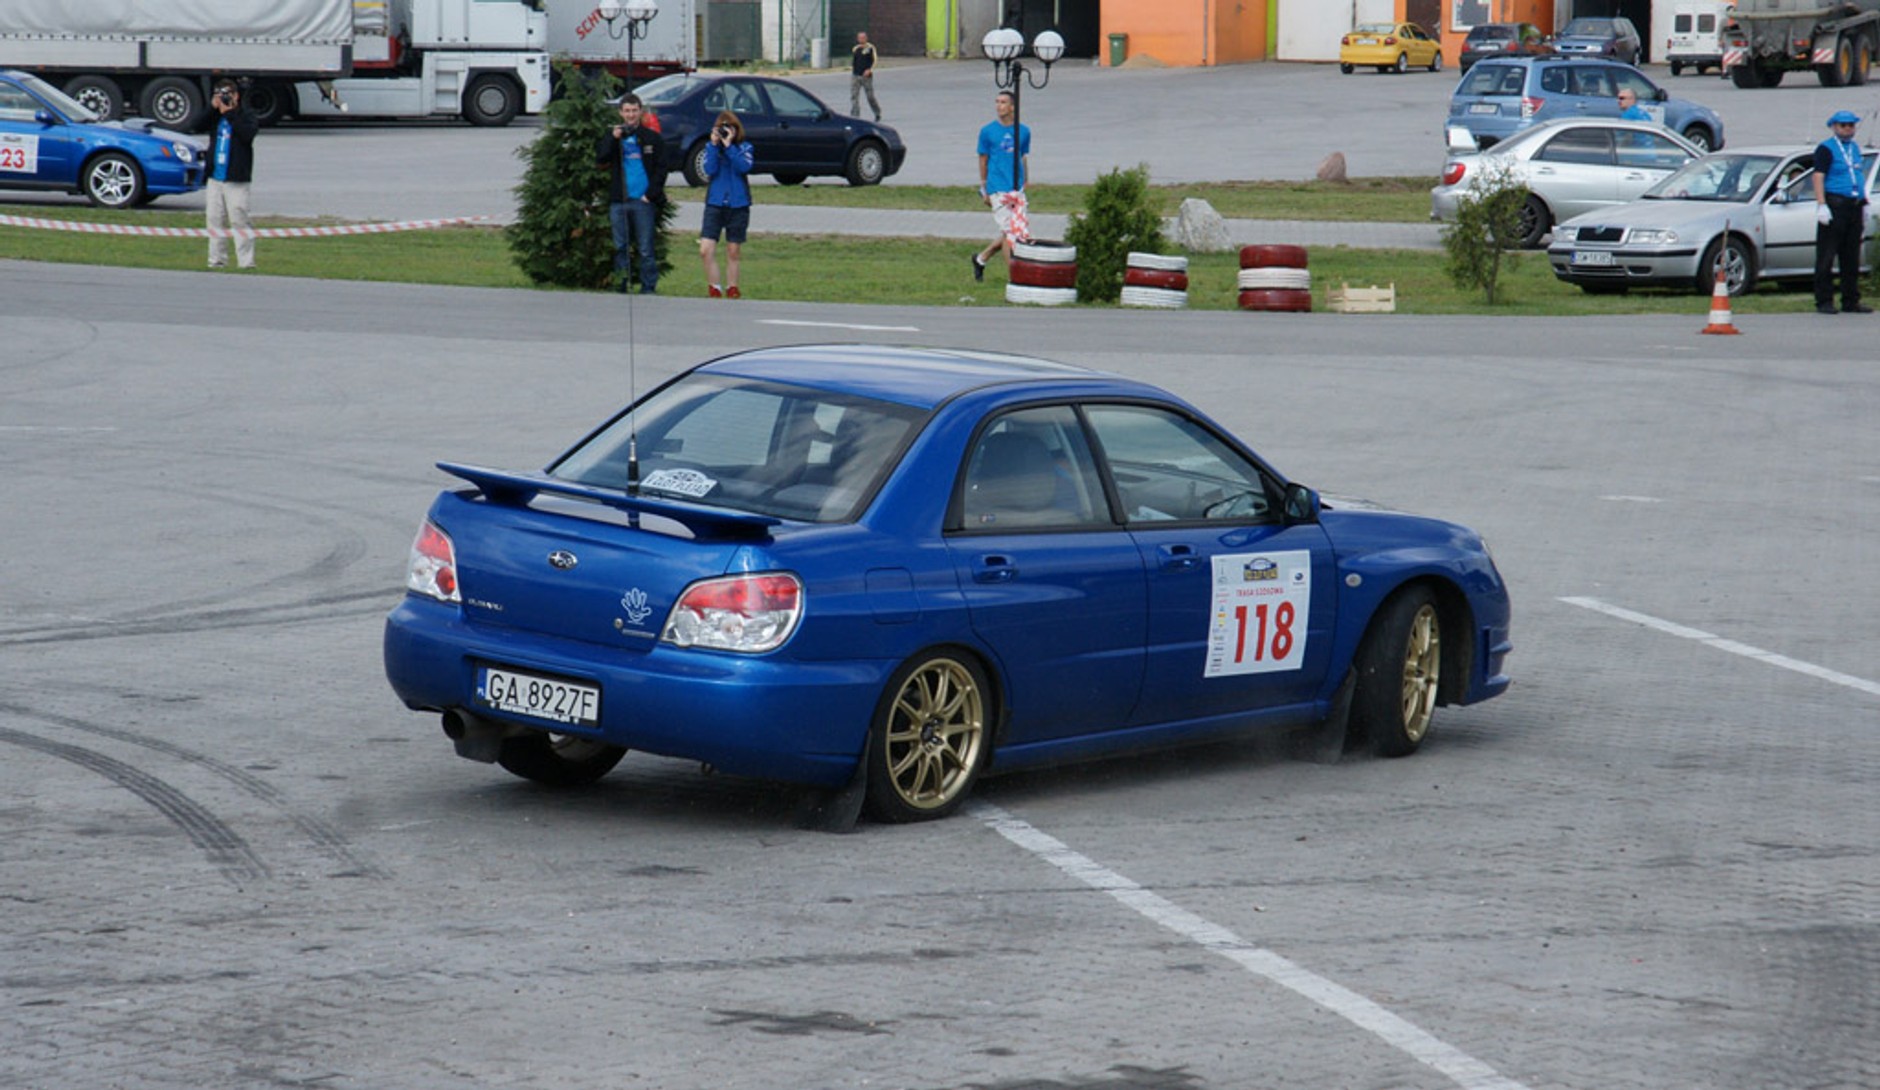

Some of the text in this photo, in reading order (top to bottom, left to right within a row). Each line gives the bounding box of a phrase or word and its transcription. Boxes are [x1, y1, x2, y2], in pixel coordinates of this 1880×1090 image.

[1234, 601, 1295, 663] 118
[489, 673, 519, 705] GA
[528, 680, 595, 717] 8927F
